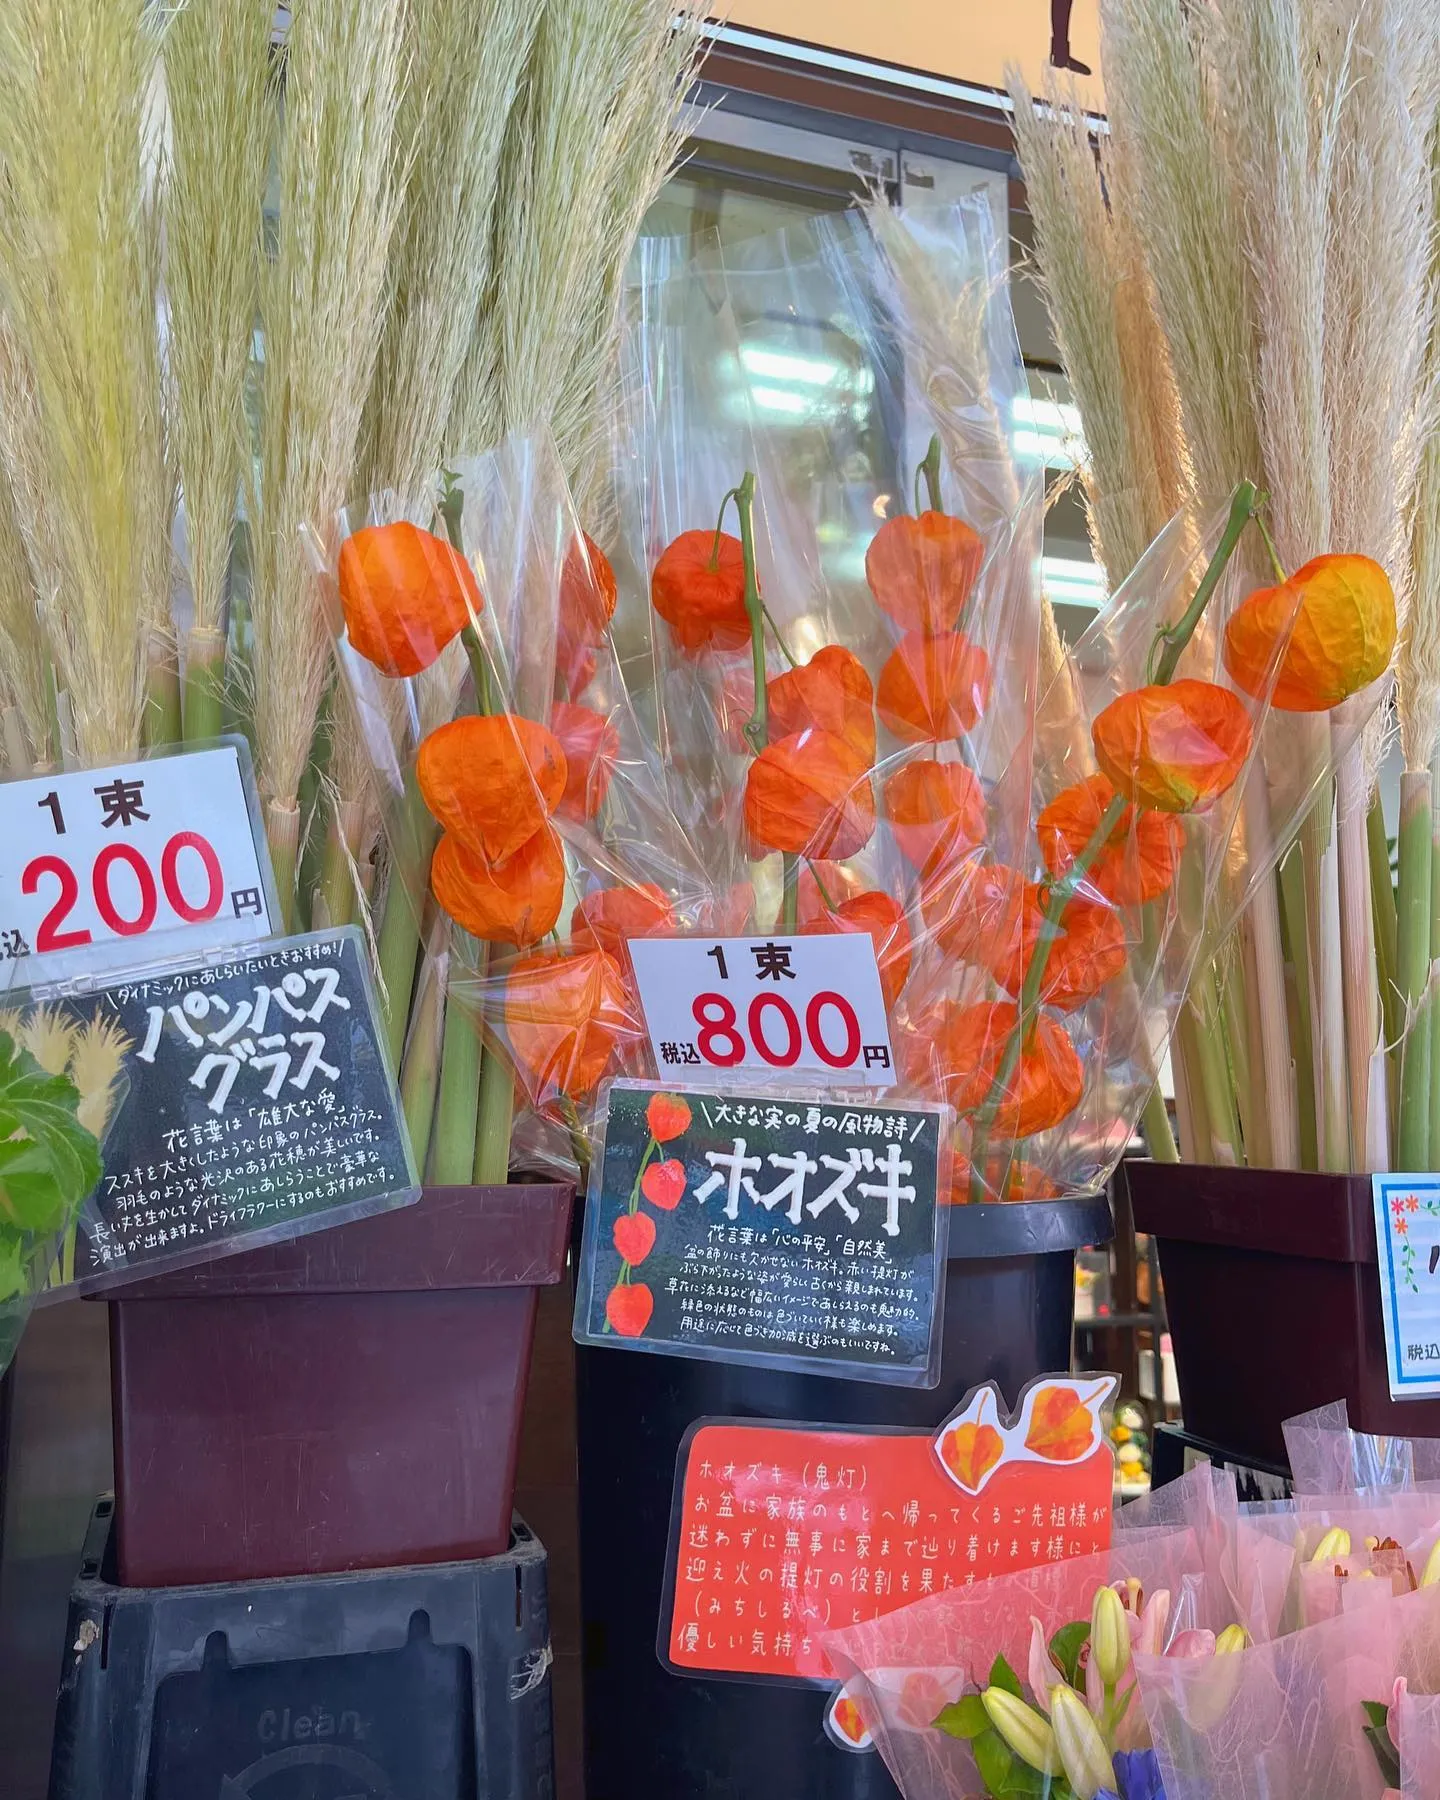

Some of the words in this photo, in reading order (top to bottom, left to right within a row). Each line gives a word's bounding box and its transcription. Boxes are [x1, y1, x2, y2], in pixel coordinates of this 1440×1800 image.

[136, 968, 350, 1063] パンパス
[188, 1032, 341, 1114] グラス
[692, 1137, 916, 1236] ホオズキ
[695, 1490, 1107, 1528] お盆に家族のもとへ帰ってくるご先祖様が
